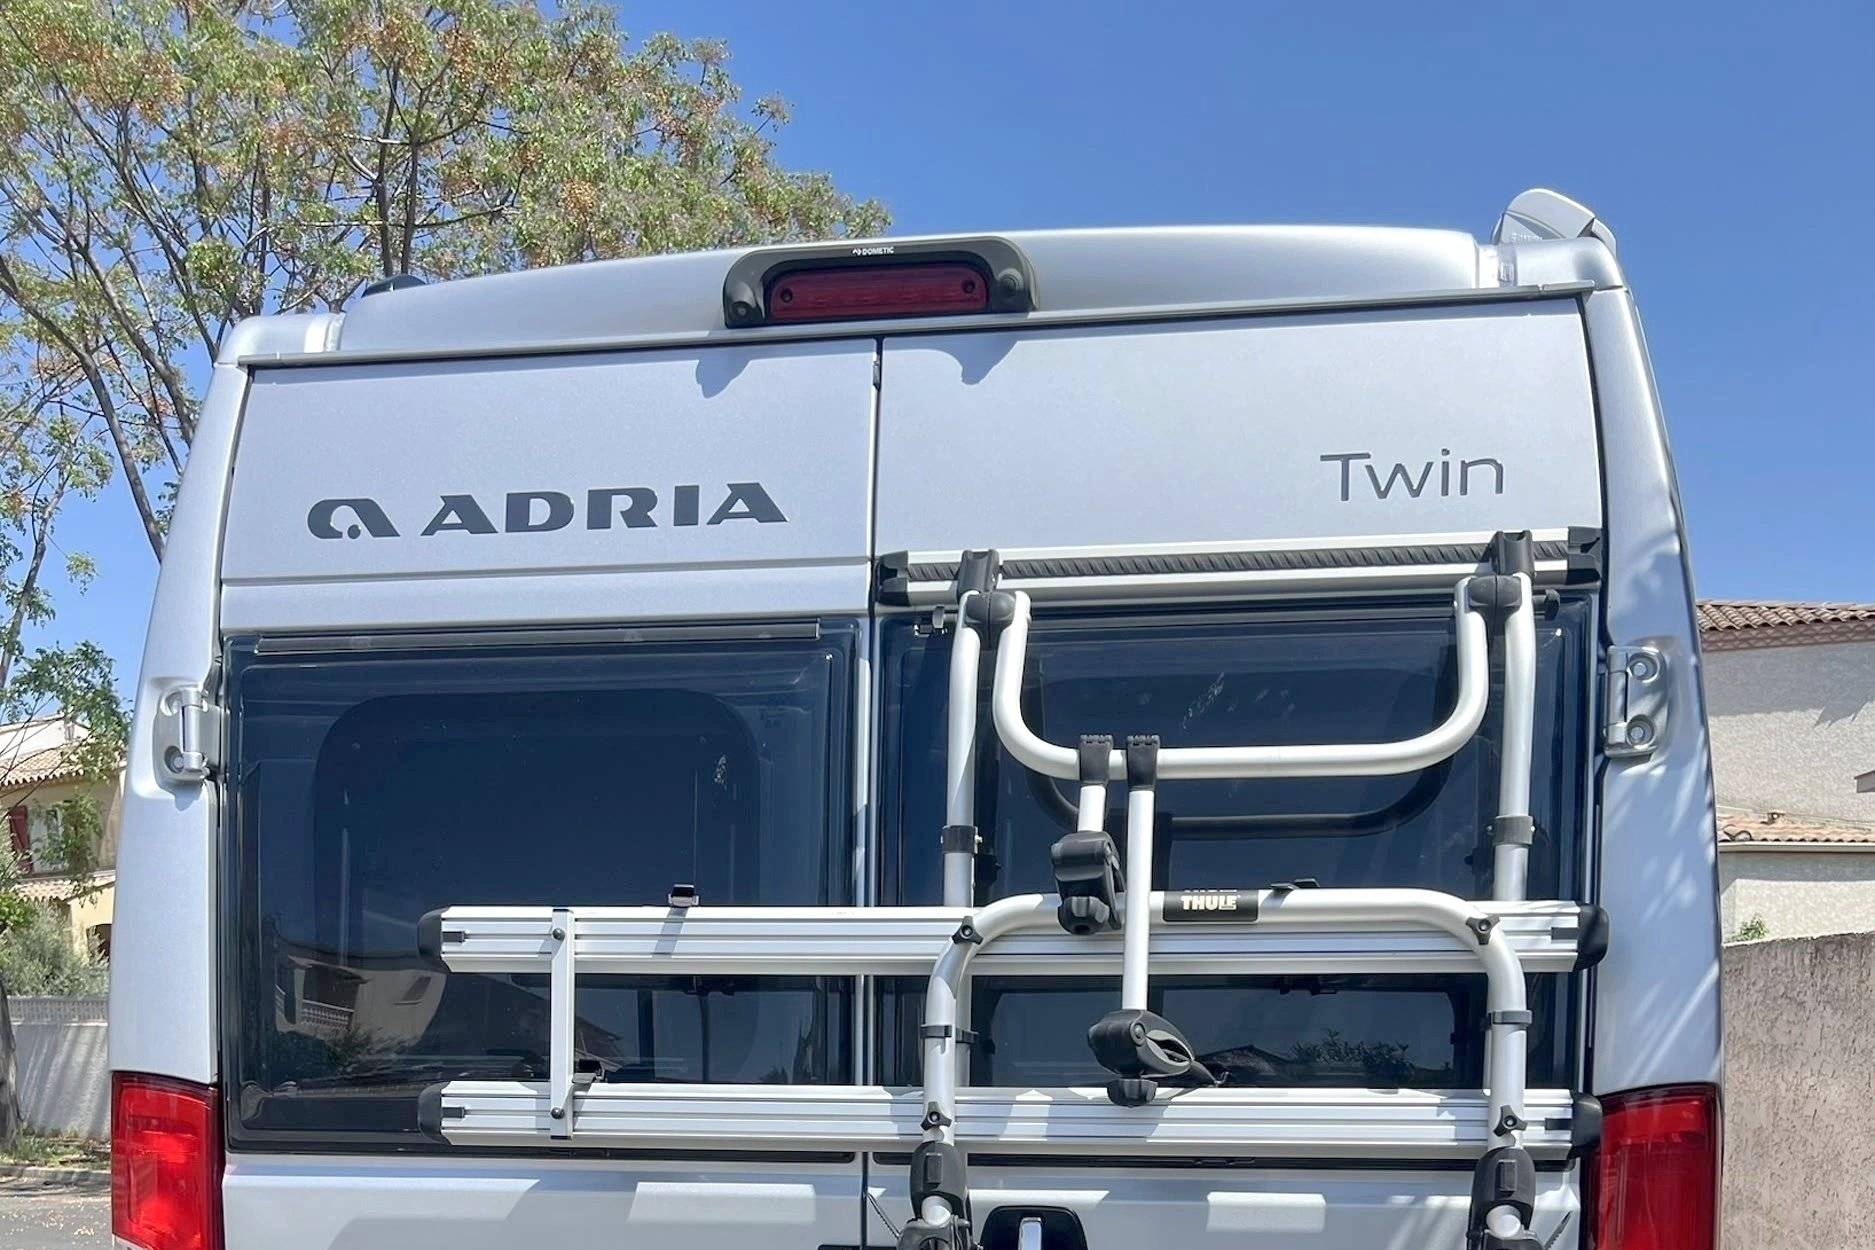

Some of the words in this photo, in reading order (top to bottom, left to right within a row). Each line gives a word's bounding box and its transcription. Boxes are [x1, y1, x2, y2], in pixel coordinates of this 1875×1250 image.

[862, 247, 895, 256] DOMETIC
[1319, 448, 1504, 502] Twin
[420, 482, 788, 537] ADRIA
[1180, 895, 1237, 910] THULE
